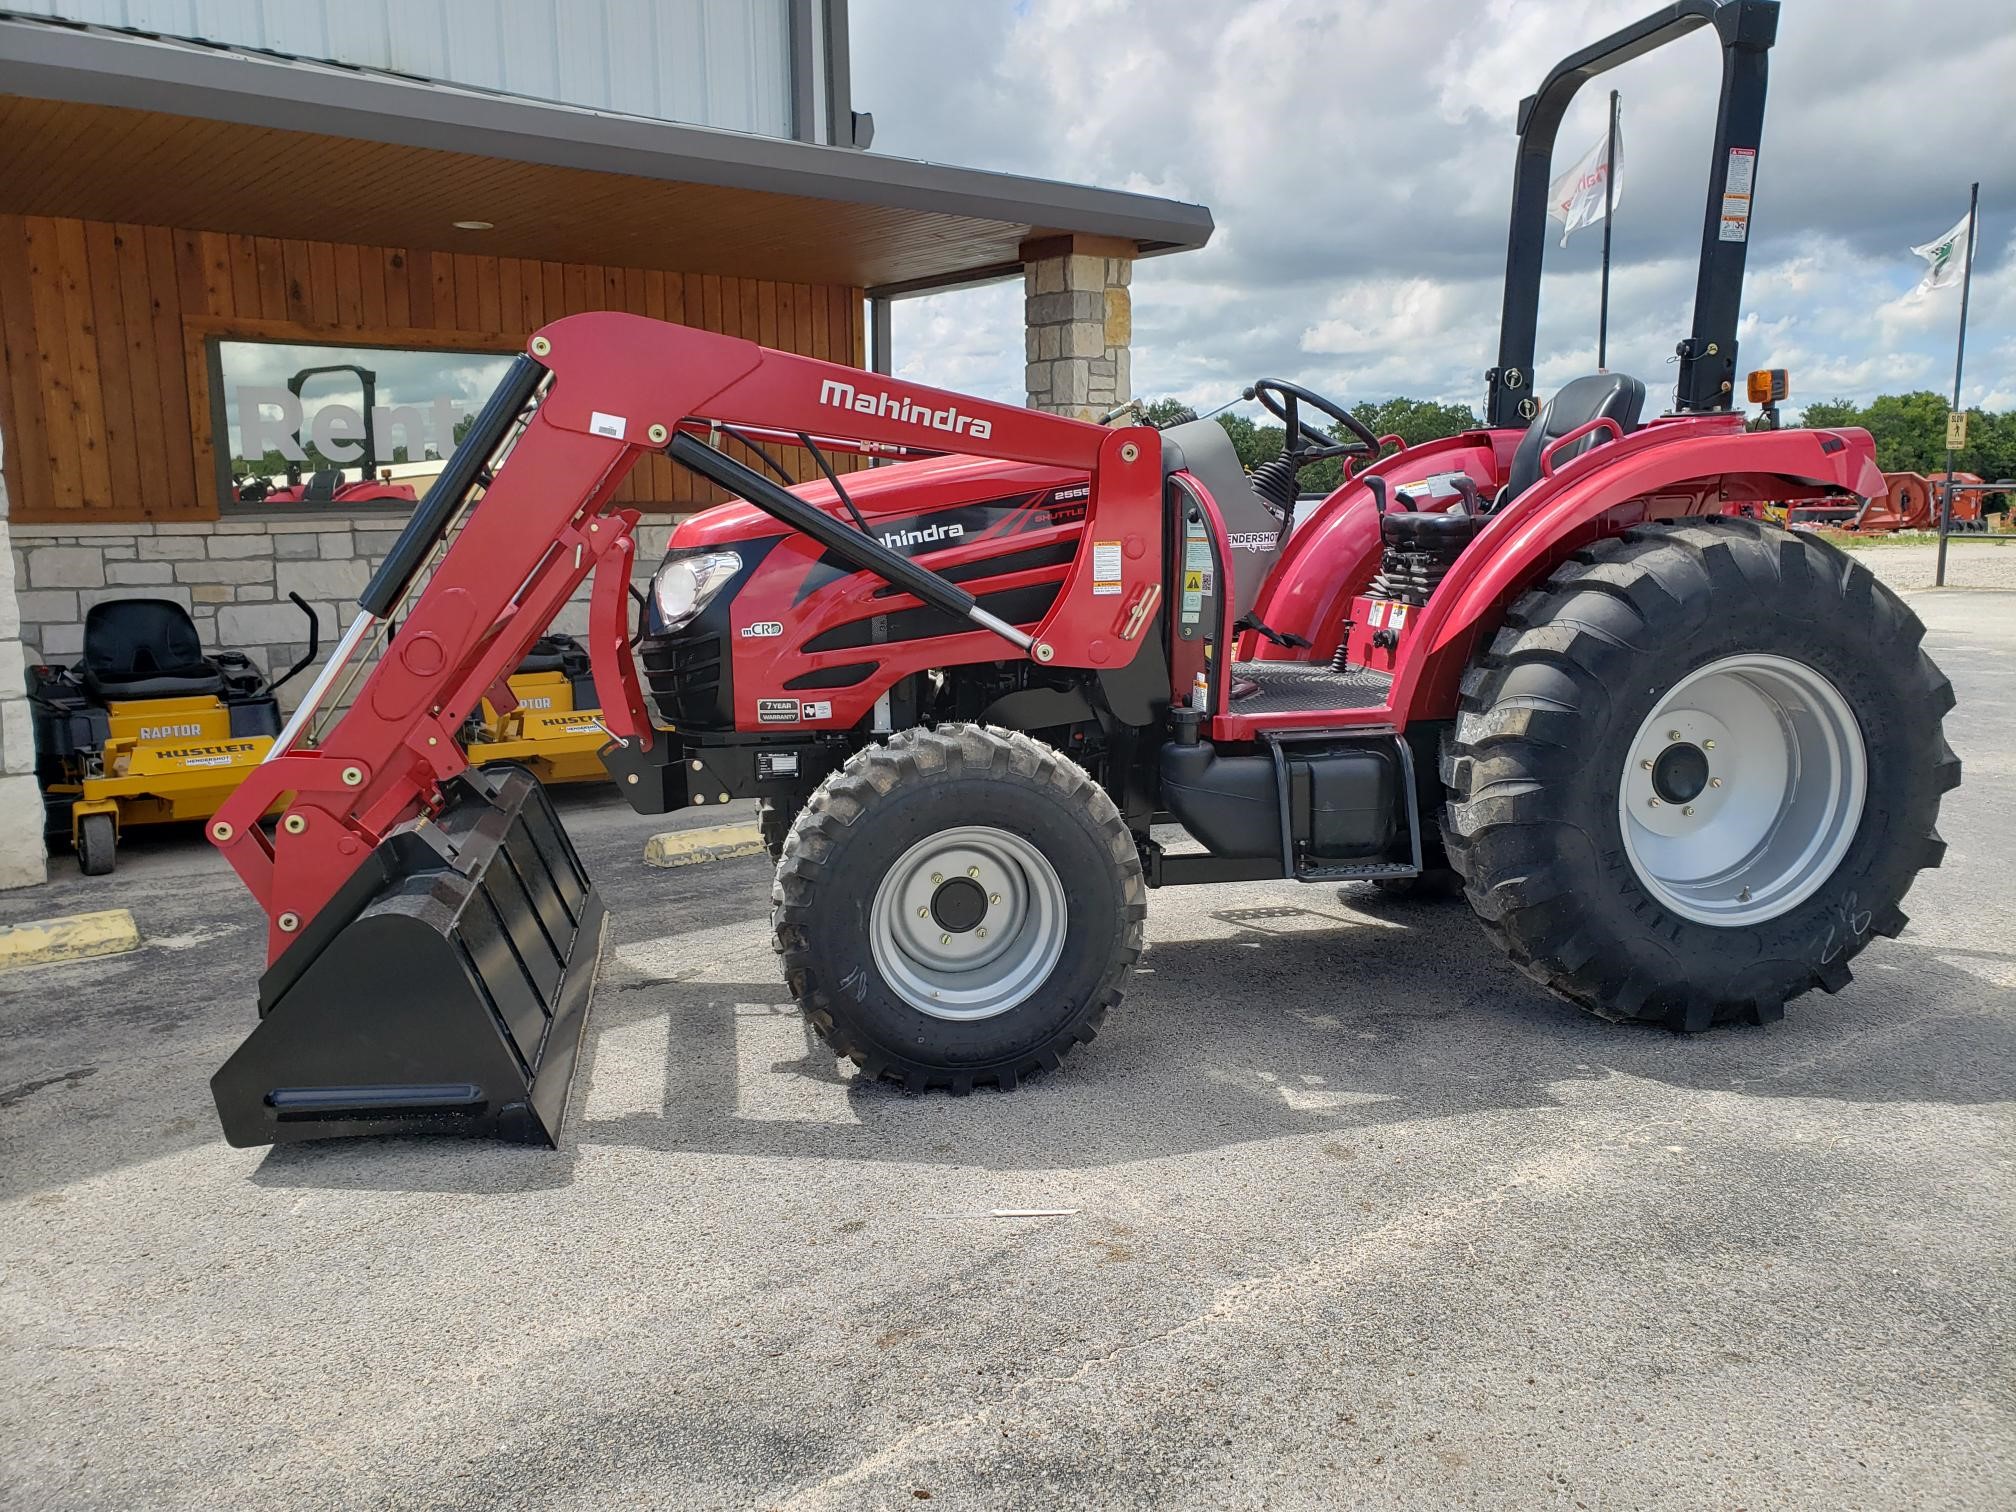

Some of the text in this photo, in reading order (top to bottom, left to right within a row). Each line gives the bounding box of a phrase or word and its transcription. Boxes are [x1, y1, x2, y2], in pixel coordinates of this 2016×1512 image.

[819, 379, 992, 440] Mahindra
[237, 386, 463, 462] Rent
[1951, 415, 1964, 423] SLOW
[1034, 508, 1085, 523] SHUTTLE
[766, 702, 772, 710] 7
[140, 724, 201, 739] RAPTOR
[155, 744, 255, 758] HUSTLER
